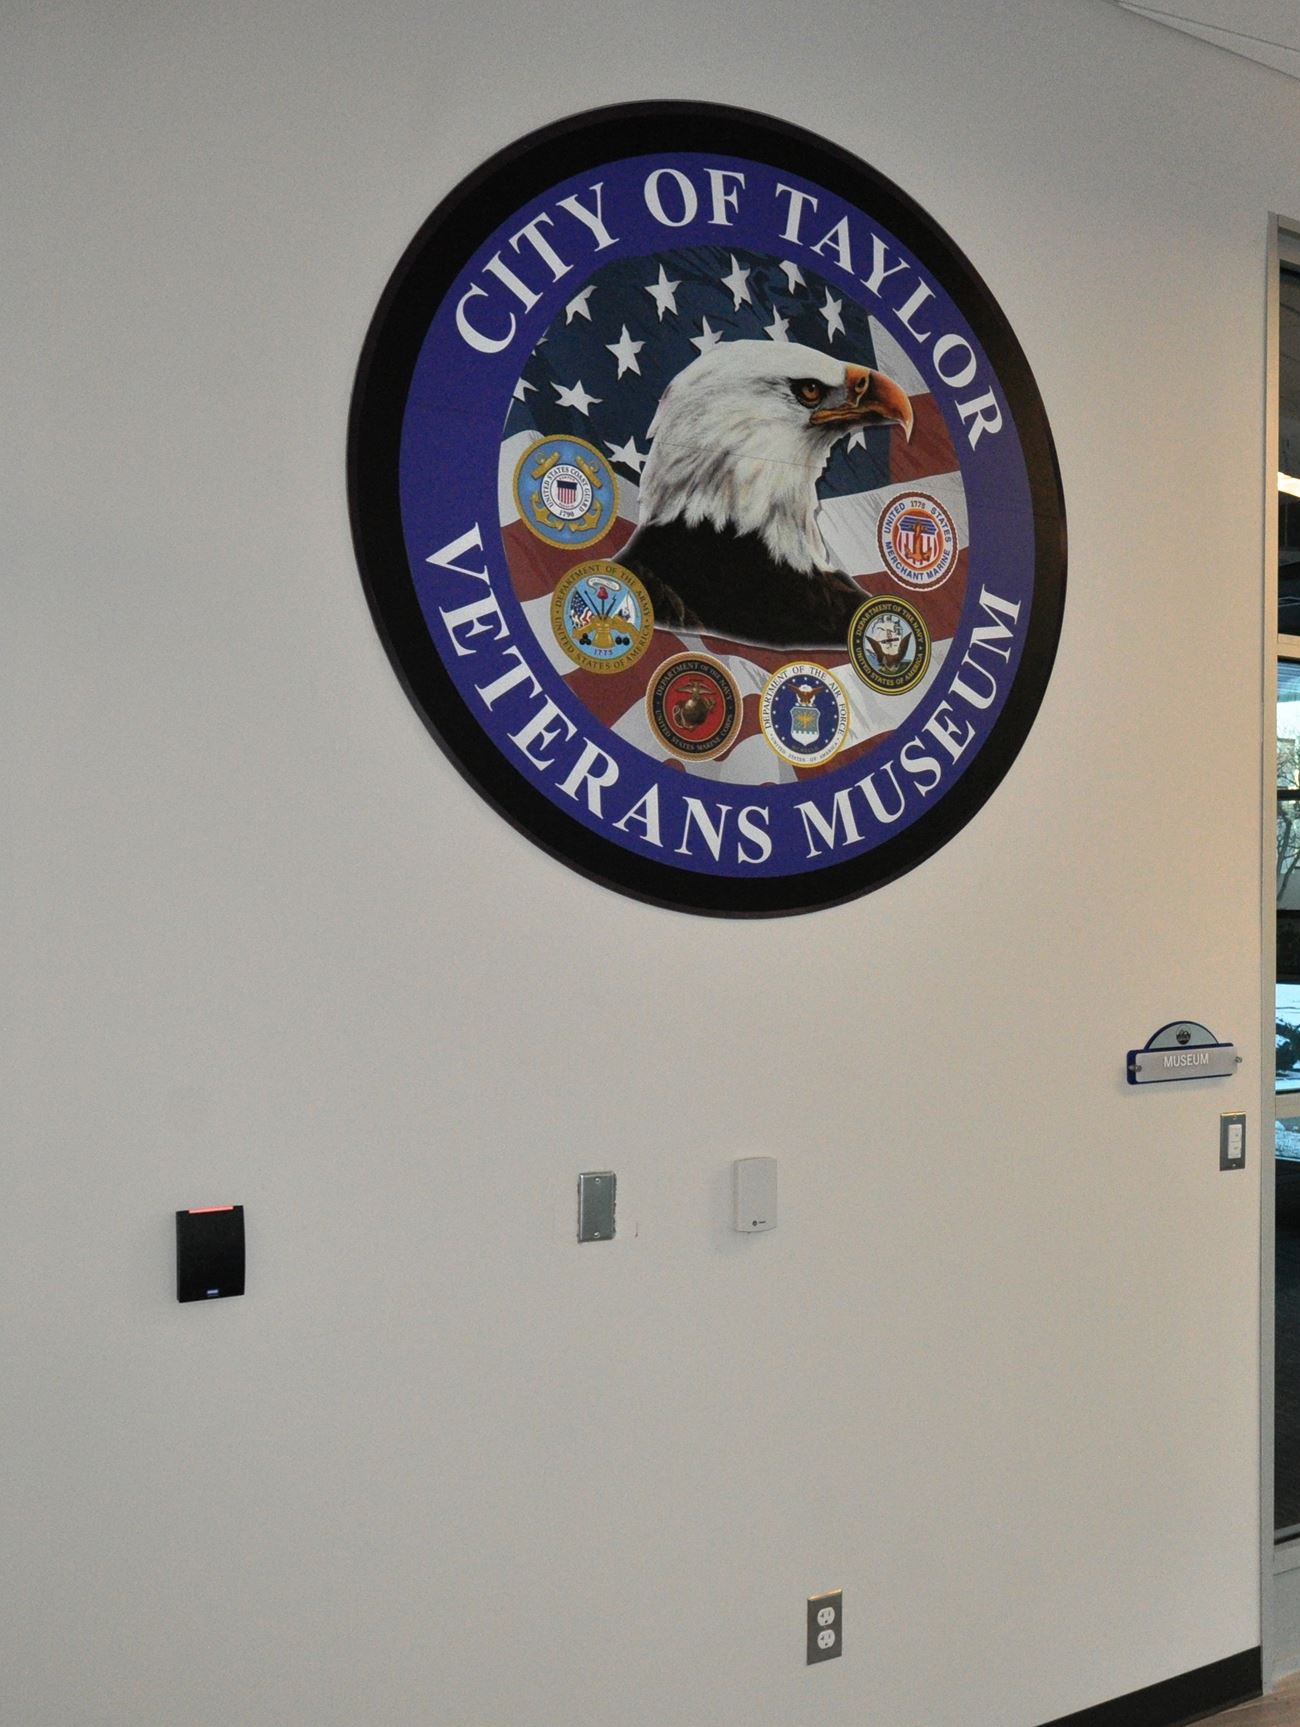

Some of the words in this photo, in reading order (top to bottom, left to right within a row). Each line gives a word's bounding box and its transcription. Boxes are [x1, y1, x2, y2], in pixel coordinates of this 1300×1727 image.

[455, 181, 620, 353] CITY
[644, 168, 746, 227] OF
[775, 183, 1003, 451] TAYLOR
[547, 466, 569, 480] STATES
[570, 467, 588, 488] COAST
[543, 481, 554, 508] UNITED
[559, 509, 575, 517] 1790
[580, 488, 590, 512] GUARD
[884, 502, 906, 534] UNITED
[930, 507, 952, 543] STATES
[885, 541, 924, 580] MERCHANT
[926, 549, 951, 579] MARINE
[555, 565, 600, 607] DEPARTMENT
[605, 565, 617, 574] OF
[621, 573, 635, 586] THE
[637, 591, 651, 617] ARMY
[856, 603, 892, 636] DEPARTMENT
[892, 604, 902, 612] OF
[902, 609, 914, 622] THE
[913, 622, 924, 643] NAVY
[555, 617, 574, 654] UNITED
[576, 651, 610, 670] STATES
[613, 659, 625, 669] OF
[626, 624, 650, 660] AMERICA
[656, 661, 699, 696] DEPARTMENT
[721, 680, 732, 701] NAVY
[856, 647, 871, 675] UNITED
[870, 672, 895, 686] STATES
[905, 653, 923, 680] AMERICA
[424, 521, 773, 864] VETERANS
[793, 583, 1022, 859] MUSEUM
[763, 671, 788, 729] DEPARTMENT
[792, 665, 805, 674] OF
[809, 667, 826, 680] THE
[829, 682, 841, 698] AIR
[838, 703, 847, 736] FORCE
[1163, 1053, 1209, 1067] MUSEUM
